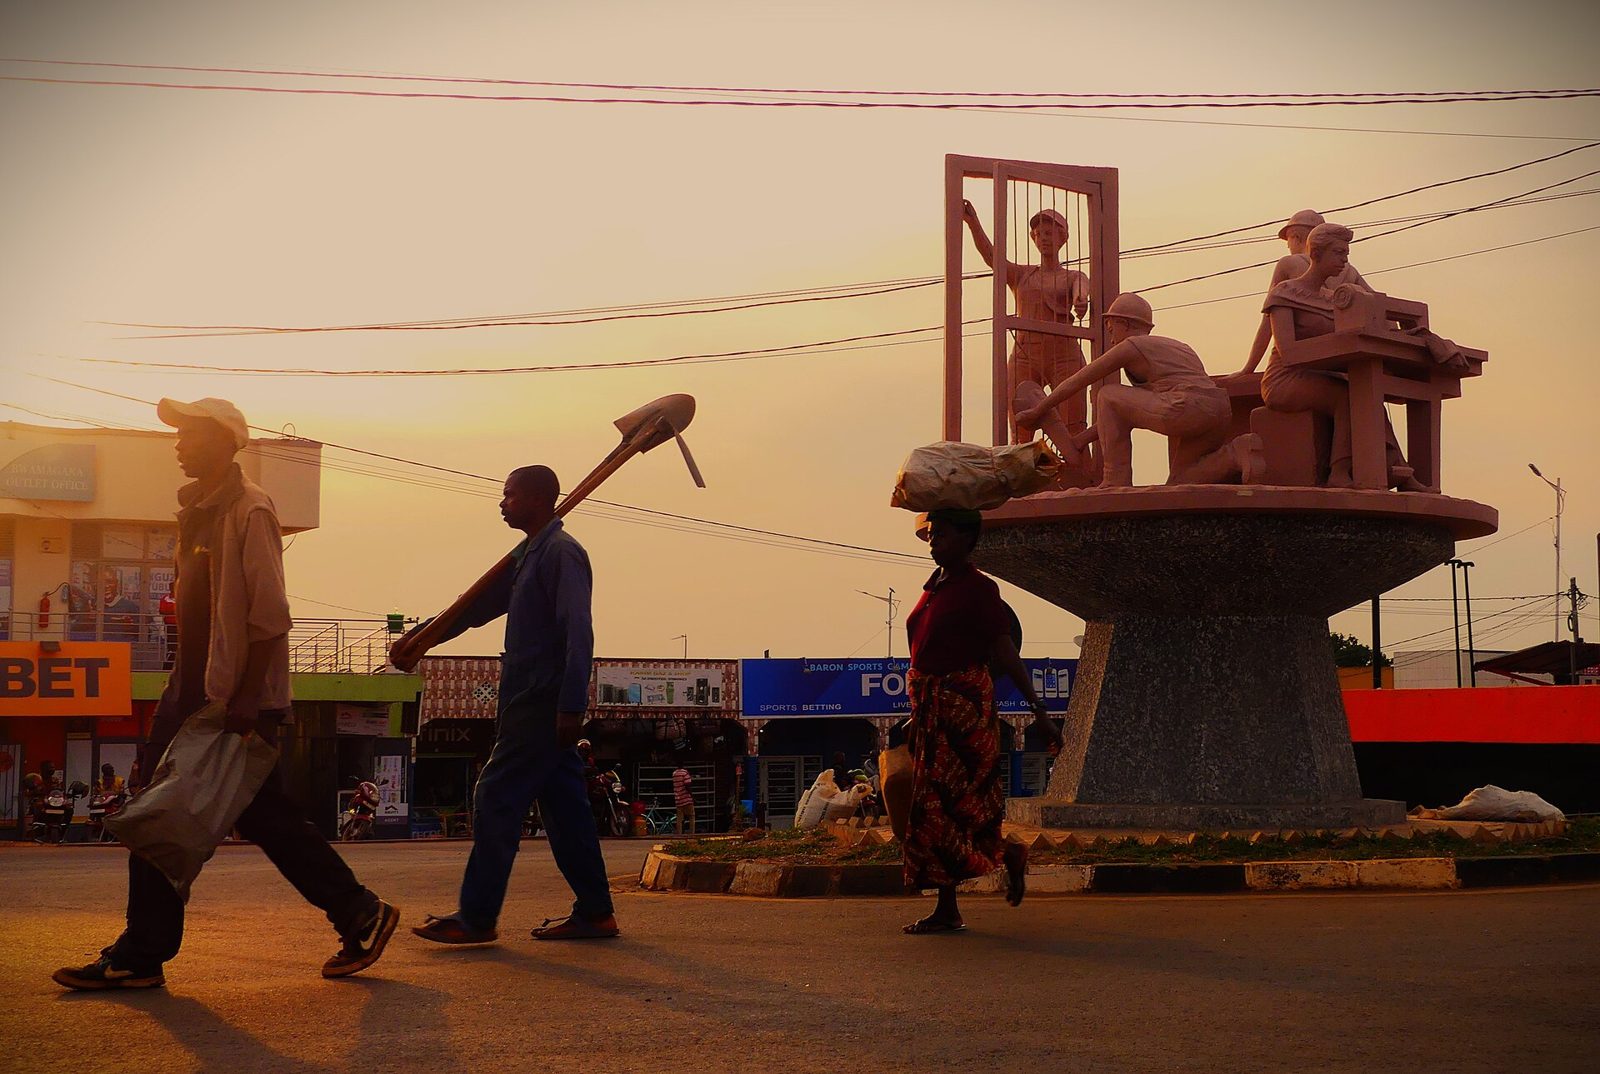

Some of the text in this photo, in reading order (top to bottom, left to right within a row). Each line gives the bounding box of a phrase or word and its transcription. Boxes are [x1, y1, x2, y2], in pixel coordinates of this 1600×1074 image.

[809, 663, 844, 673] BARON
[847, 662, 883, 671] SPORTS
[0, 657, 110, 698] BET
[802, 703, 842, 711] BETTING
